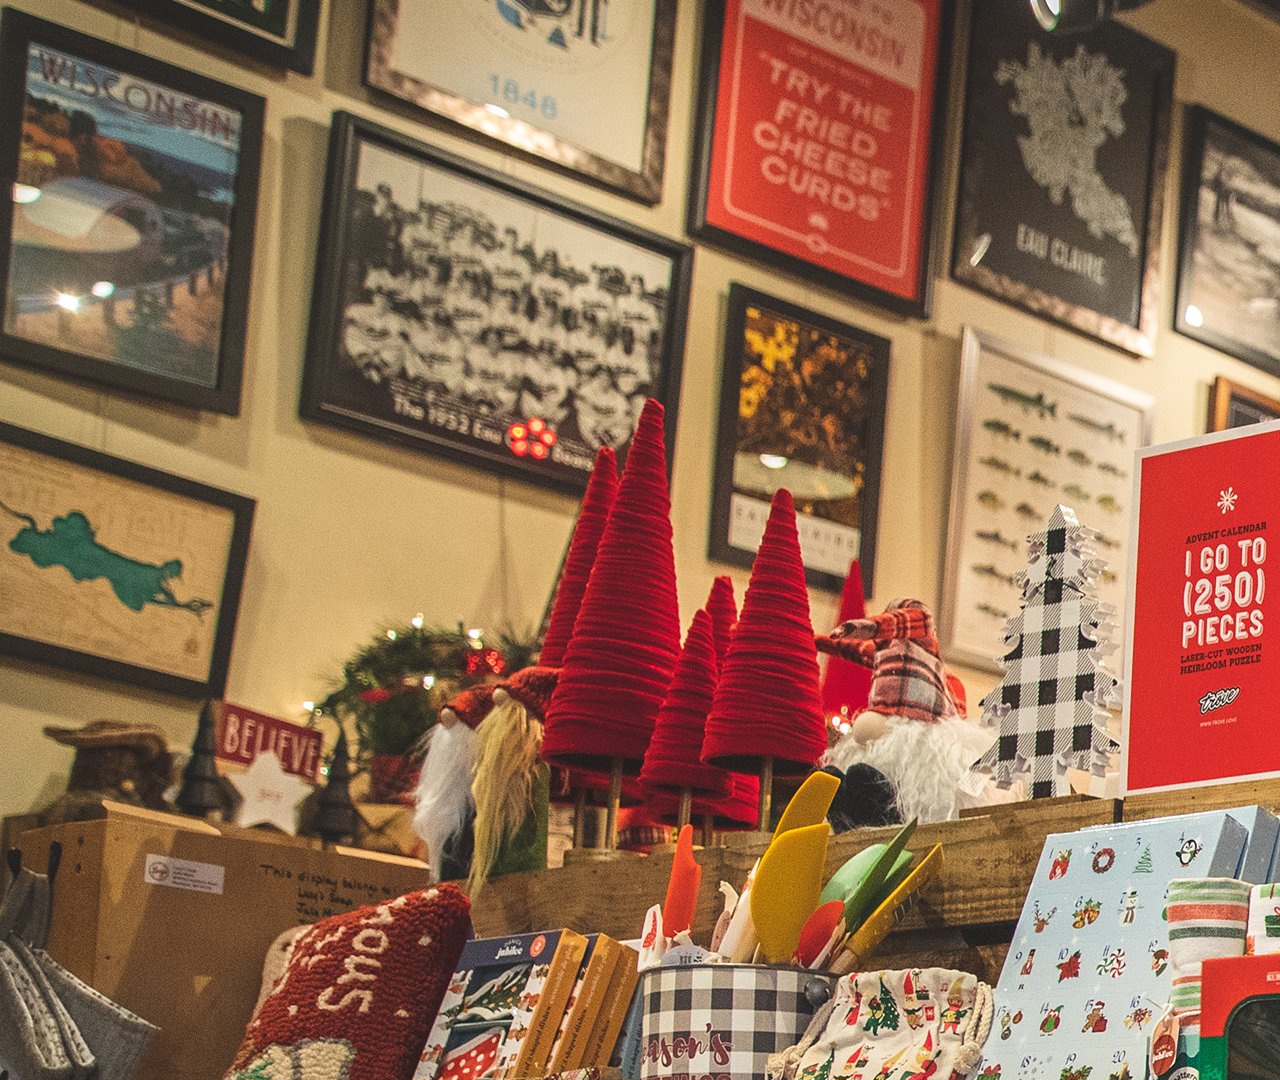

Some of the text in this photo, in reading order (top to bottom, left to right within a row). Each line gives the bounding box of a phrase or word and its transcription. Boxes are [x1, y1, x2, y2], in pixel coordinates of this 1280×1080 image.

[38, 51, 234, 140] WISCONSIN
[490, 73, 558, 120] 1848
[836, 91, 892, 133] THE
[774, 100, 878, 158] FRIED
[753, 121, 892, 193] CHEESE
[1186, 521, 1267, 544] ADVENT CALENDAR
[1185, 537, 1267, 577] I GO TO
[1183, 568, 1266, 617] (250)
[1182, 609, 1264, 649] PIECES
[1180, 643, 1263, 664] LASER-CUT WOODEN
[1180, 654, 1262, 675] HEIRLOOM PUZZLE
[641, 1022, 734, 1068] ason's
